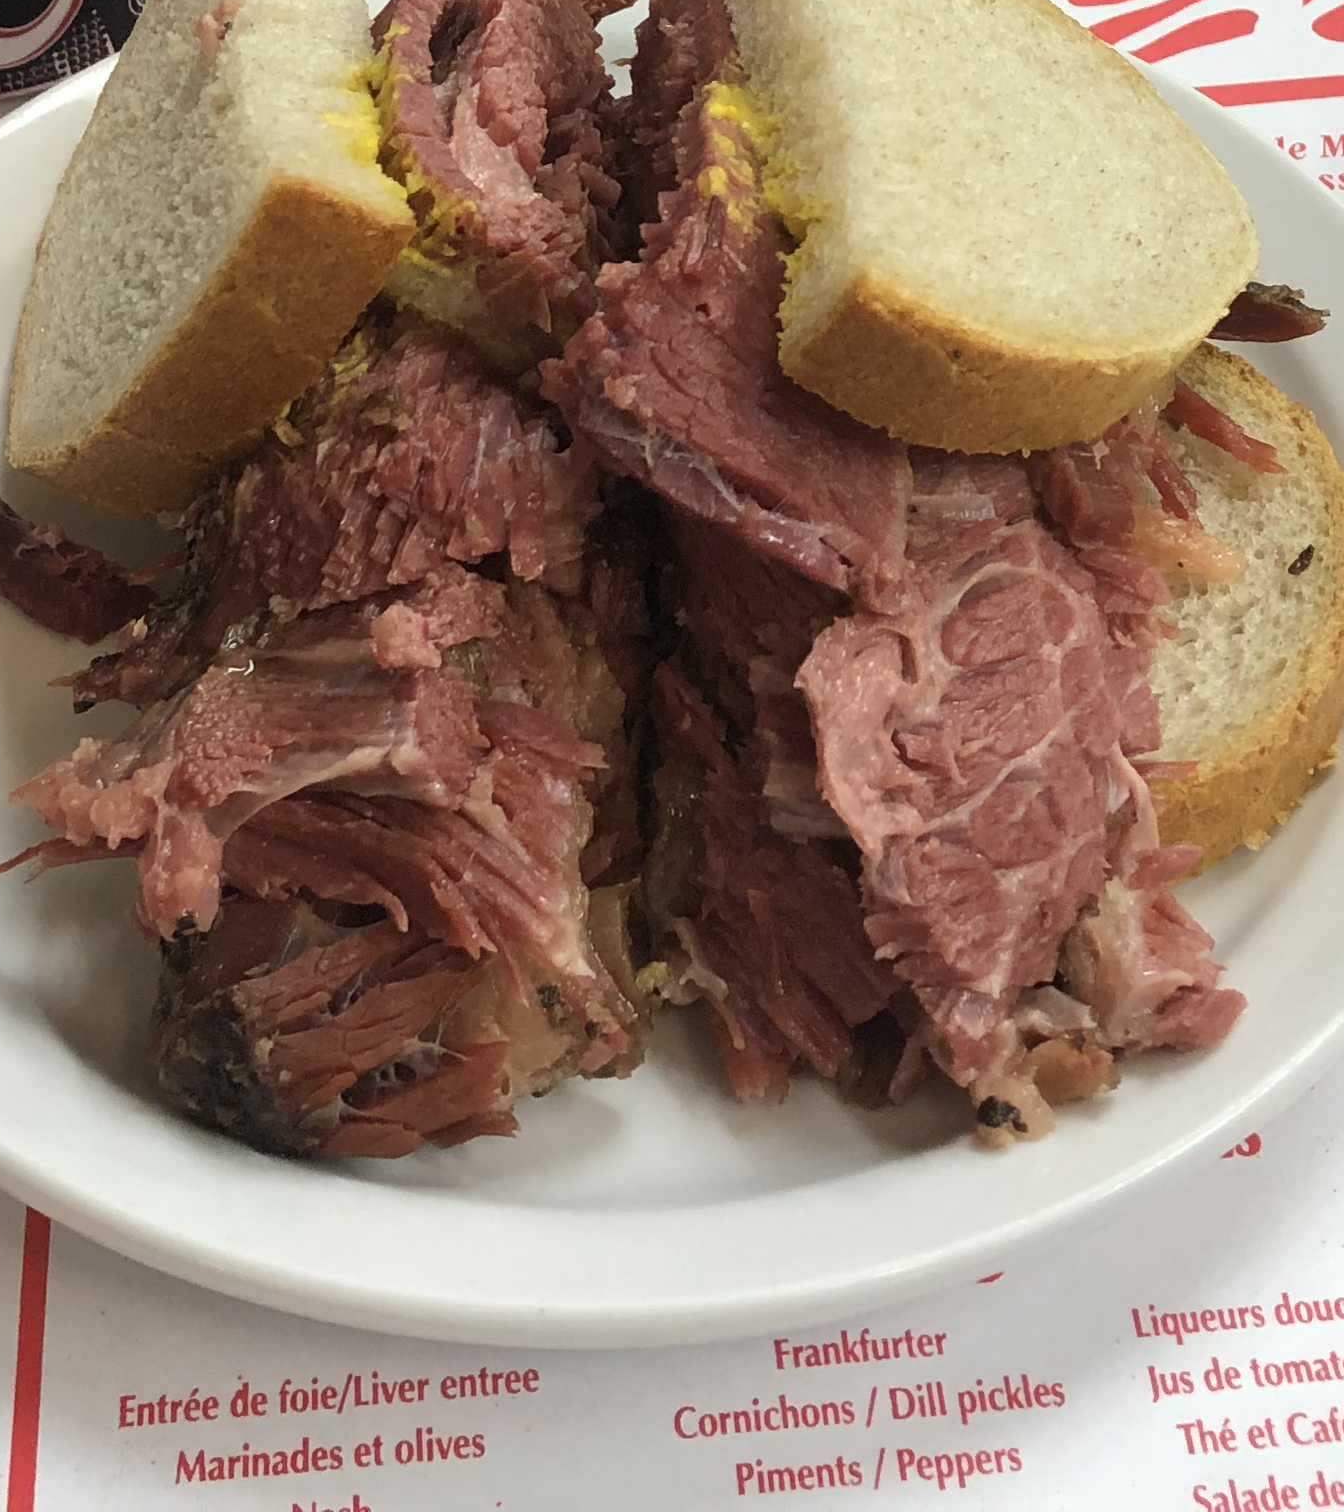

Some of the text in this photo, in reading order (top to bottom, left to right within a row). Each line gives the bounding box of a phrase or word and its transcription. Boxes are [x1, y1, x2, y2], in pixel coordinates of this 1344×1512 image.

[774, 1328, 947, 1369] Frankfurter
[1130, 1305, 1266, 1346] Liqueurs
[119, 1368, 540, 1431] Entrée de foie/Liver entree
[1148, 1367, 1195, 1403] Jus
[1204, 1357, 1242, 1392] de
[674, 1374, 1066, 1439] Cornichons / Dill pickles
[176, 1428, 486, 1484] Marinades et olives
[1178, 1419, 1237, 1454] Thé
[1247, 1418, 1278, 1450] et
[736, 1448, 1024, 1496] Piments / Peppers
[1194, 1477, 1299, 1512] Salade
